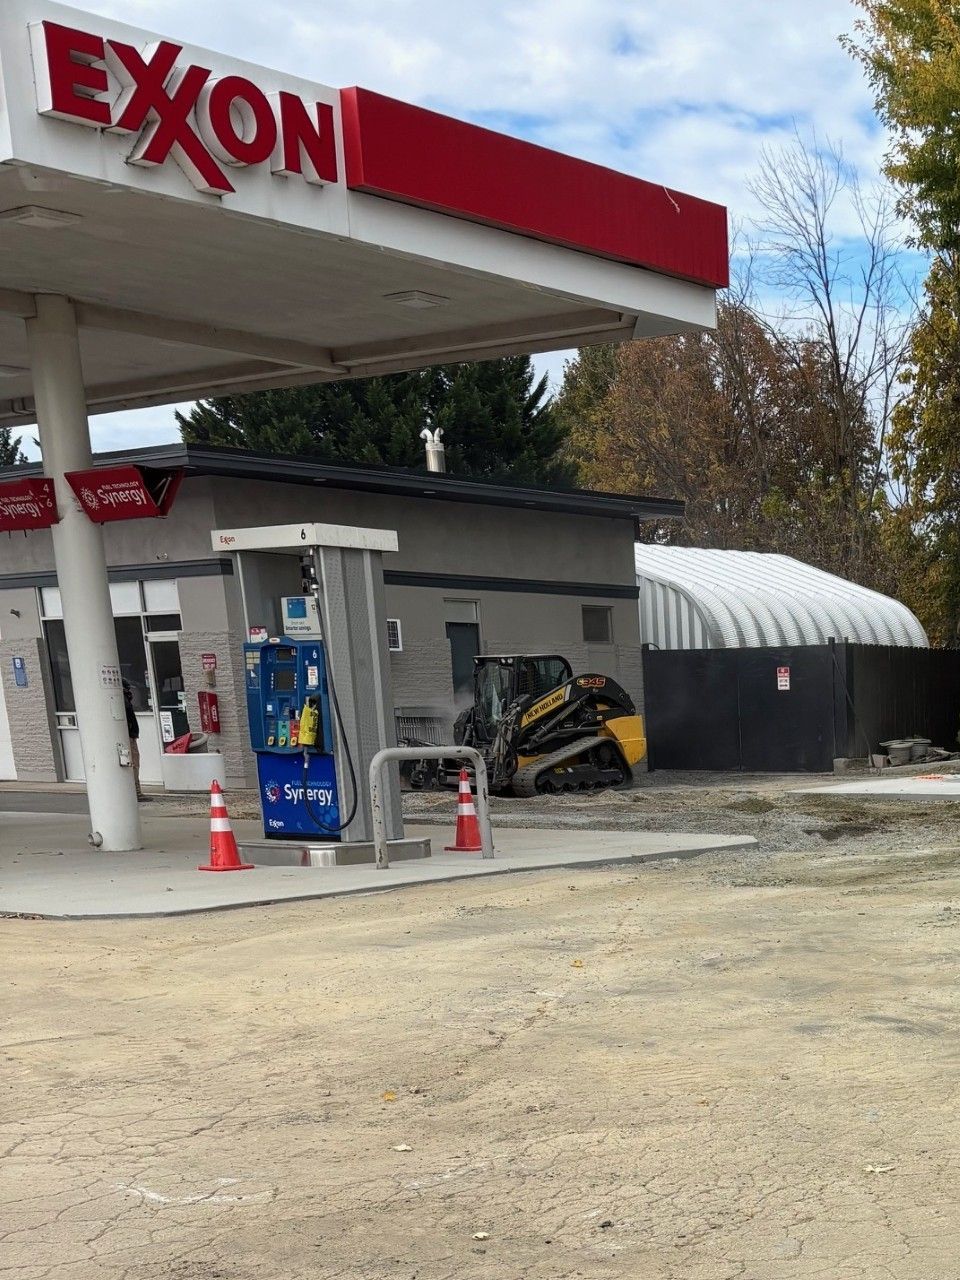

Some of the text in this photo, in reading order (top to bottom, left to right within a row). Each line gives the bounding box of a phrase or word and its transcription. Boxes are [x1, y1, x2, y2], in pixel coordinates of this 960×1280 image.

[36, 20, 338, 193] EXXON
[43, 484, 50, 493] 4
[46, 498, 53, 508] 6
[97, 488, 147, 508] Synergy
[0, 502, 42, 519] Synergy
[220, 535, 235, 545] Exxon
[301, 529, 306, 540] 6
[313, 649, 318, 659] 6
[527, 693, 563, 719] NEW HOLLAND
[284, 784, 332, 805] Synergy
[269, 819, 284, 829] Exxon
